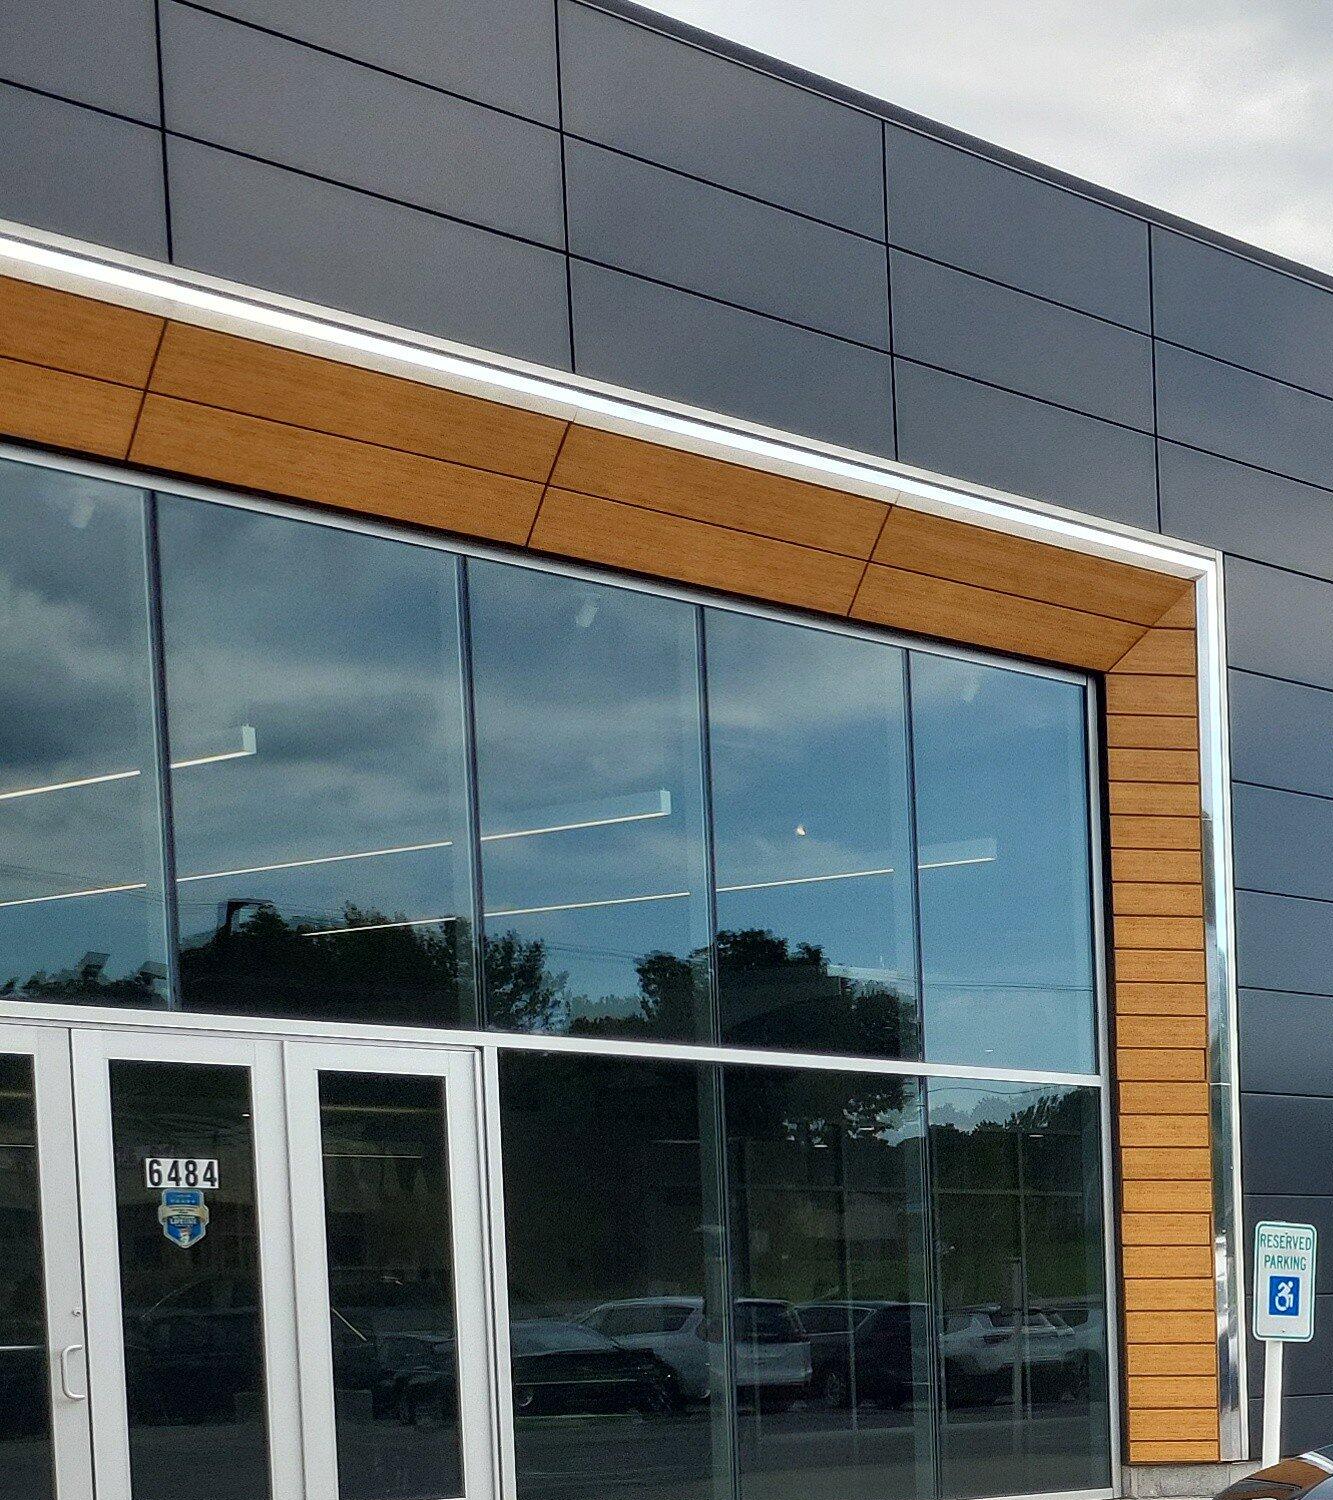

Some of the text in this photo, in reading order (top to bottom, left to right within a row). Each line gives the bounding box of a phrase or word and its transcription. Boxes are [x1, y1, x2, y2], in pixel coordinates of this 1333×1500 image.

[148, 1158, 218, 1188] 6484
[1260, 1233, 1312, 1251] RESERVED
[1264, 1254, 1307, 1271] PARKING
